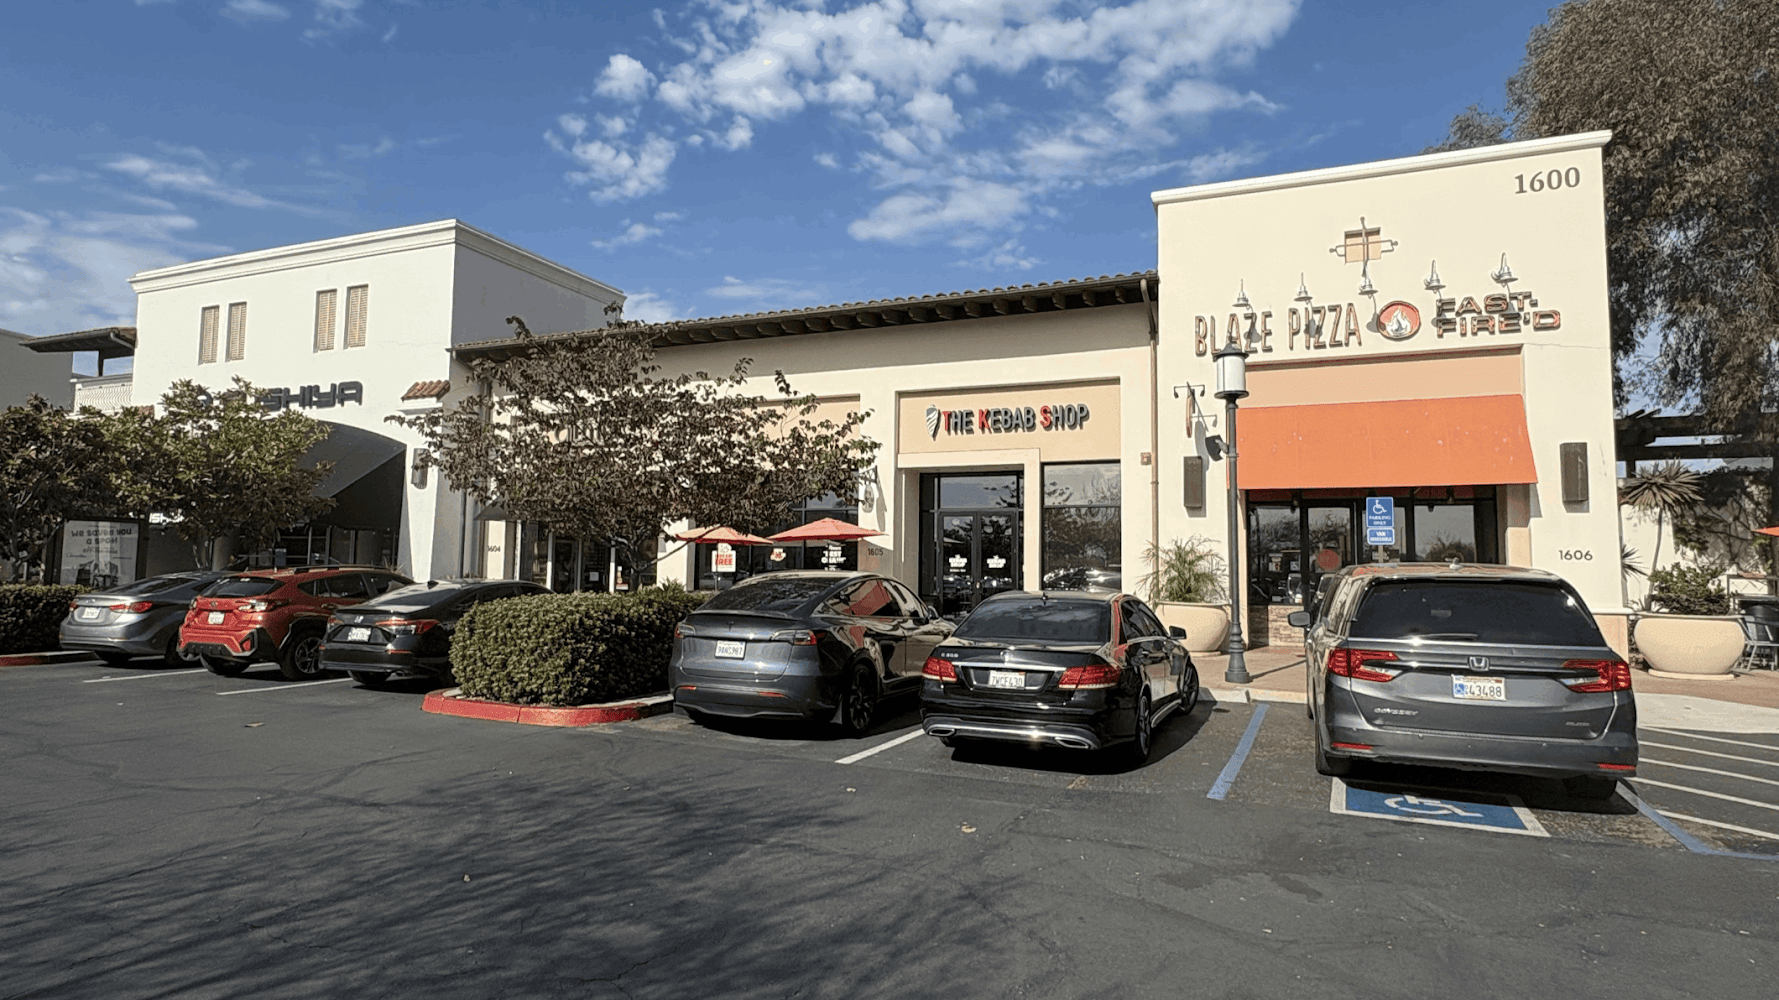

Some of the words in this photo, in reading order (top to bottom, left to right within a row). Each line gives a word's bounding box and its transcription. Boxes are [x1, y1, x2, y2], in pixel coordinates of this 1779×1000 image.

[1514, 167, 1580, 194] 1600
[1195, 312, 1273, 358] BLAZE
[1288, 303, 1362, 351] PIZZA
[1437, 310, 1561, 338] FIRE'D
[942, 410, 974, 435] THE
[979, 407, 1036, 433] KEBAB
[1040, 404, 1090, 429] SHOP
[867, 548, 884, 556] 1605
[1558, 549, 1594, 561] 1606
[1373, 708, 1419, 716] ODYSSEY
